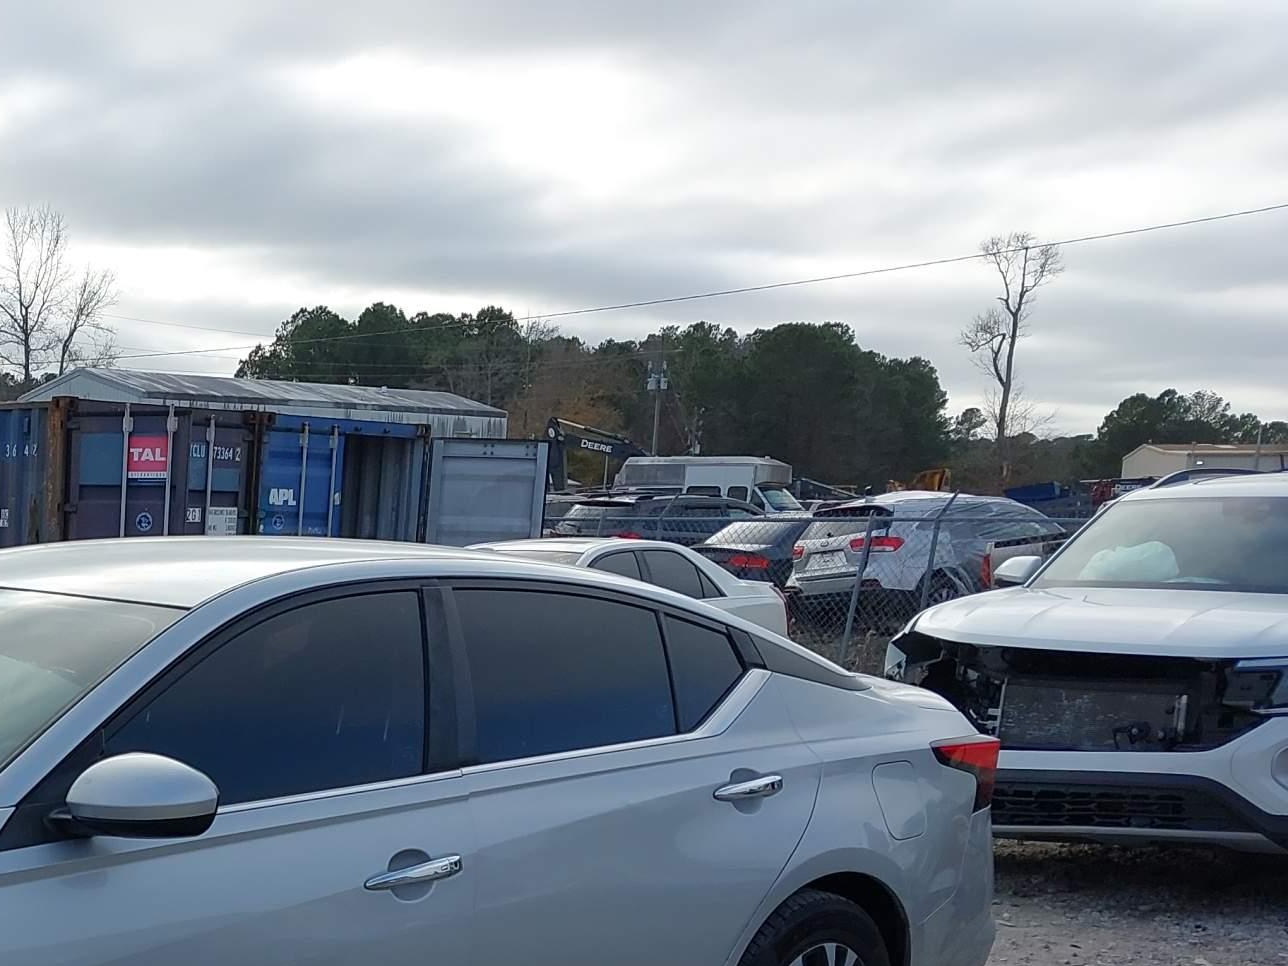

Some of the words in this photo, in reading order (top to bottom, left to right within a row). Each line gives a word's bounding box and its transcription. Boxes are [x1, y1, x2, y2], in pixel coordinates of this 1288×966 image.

[580, 439, 613, 453] DEERE
[129, 447, 167, 462] TAL
[268, 488, 297, 506] APL
